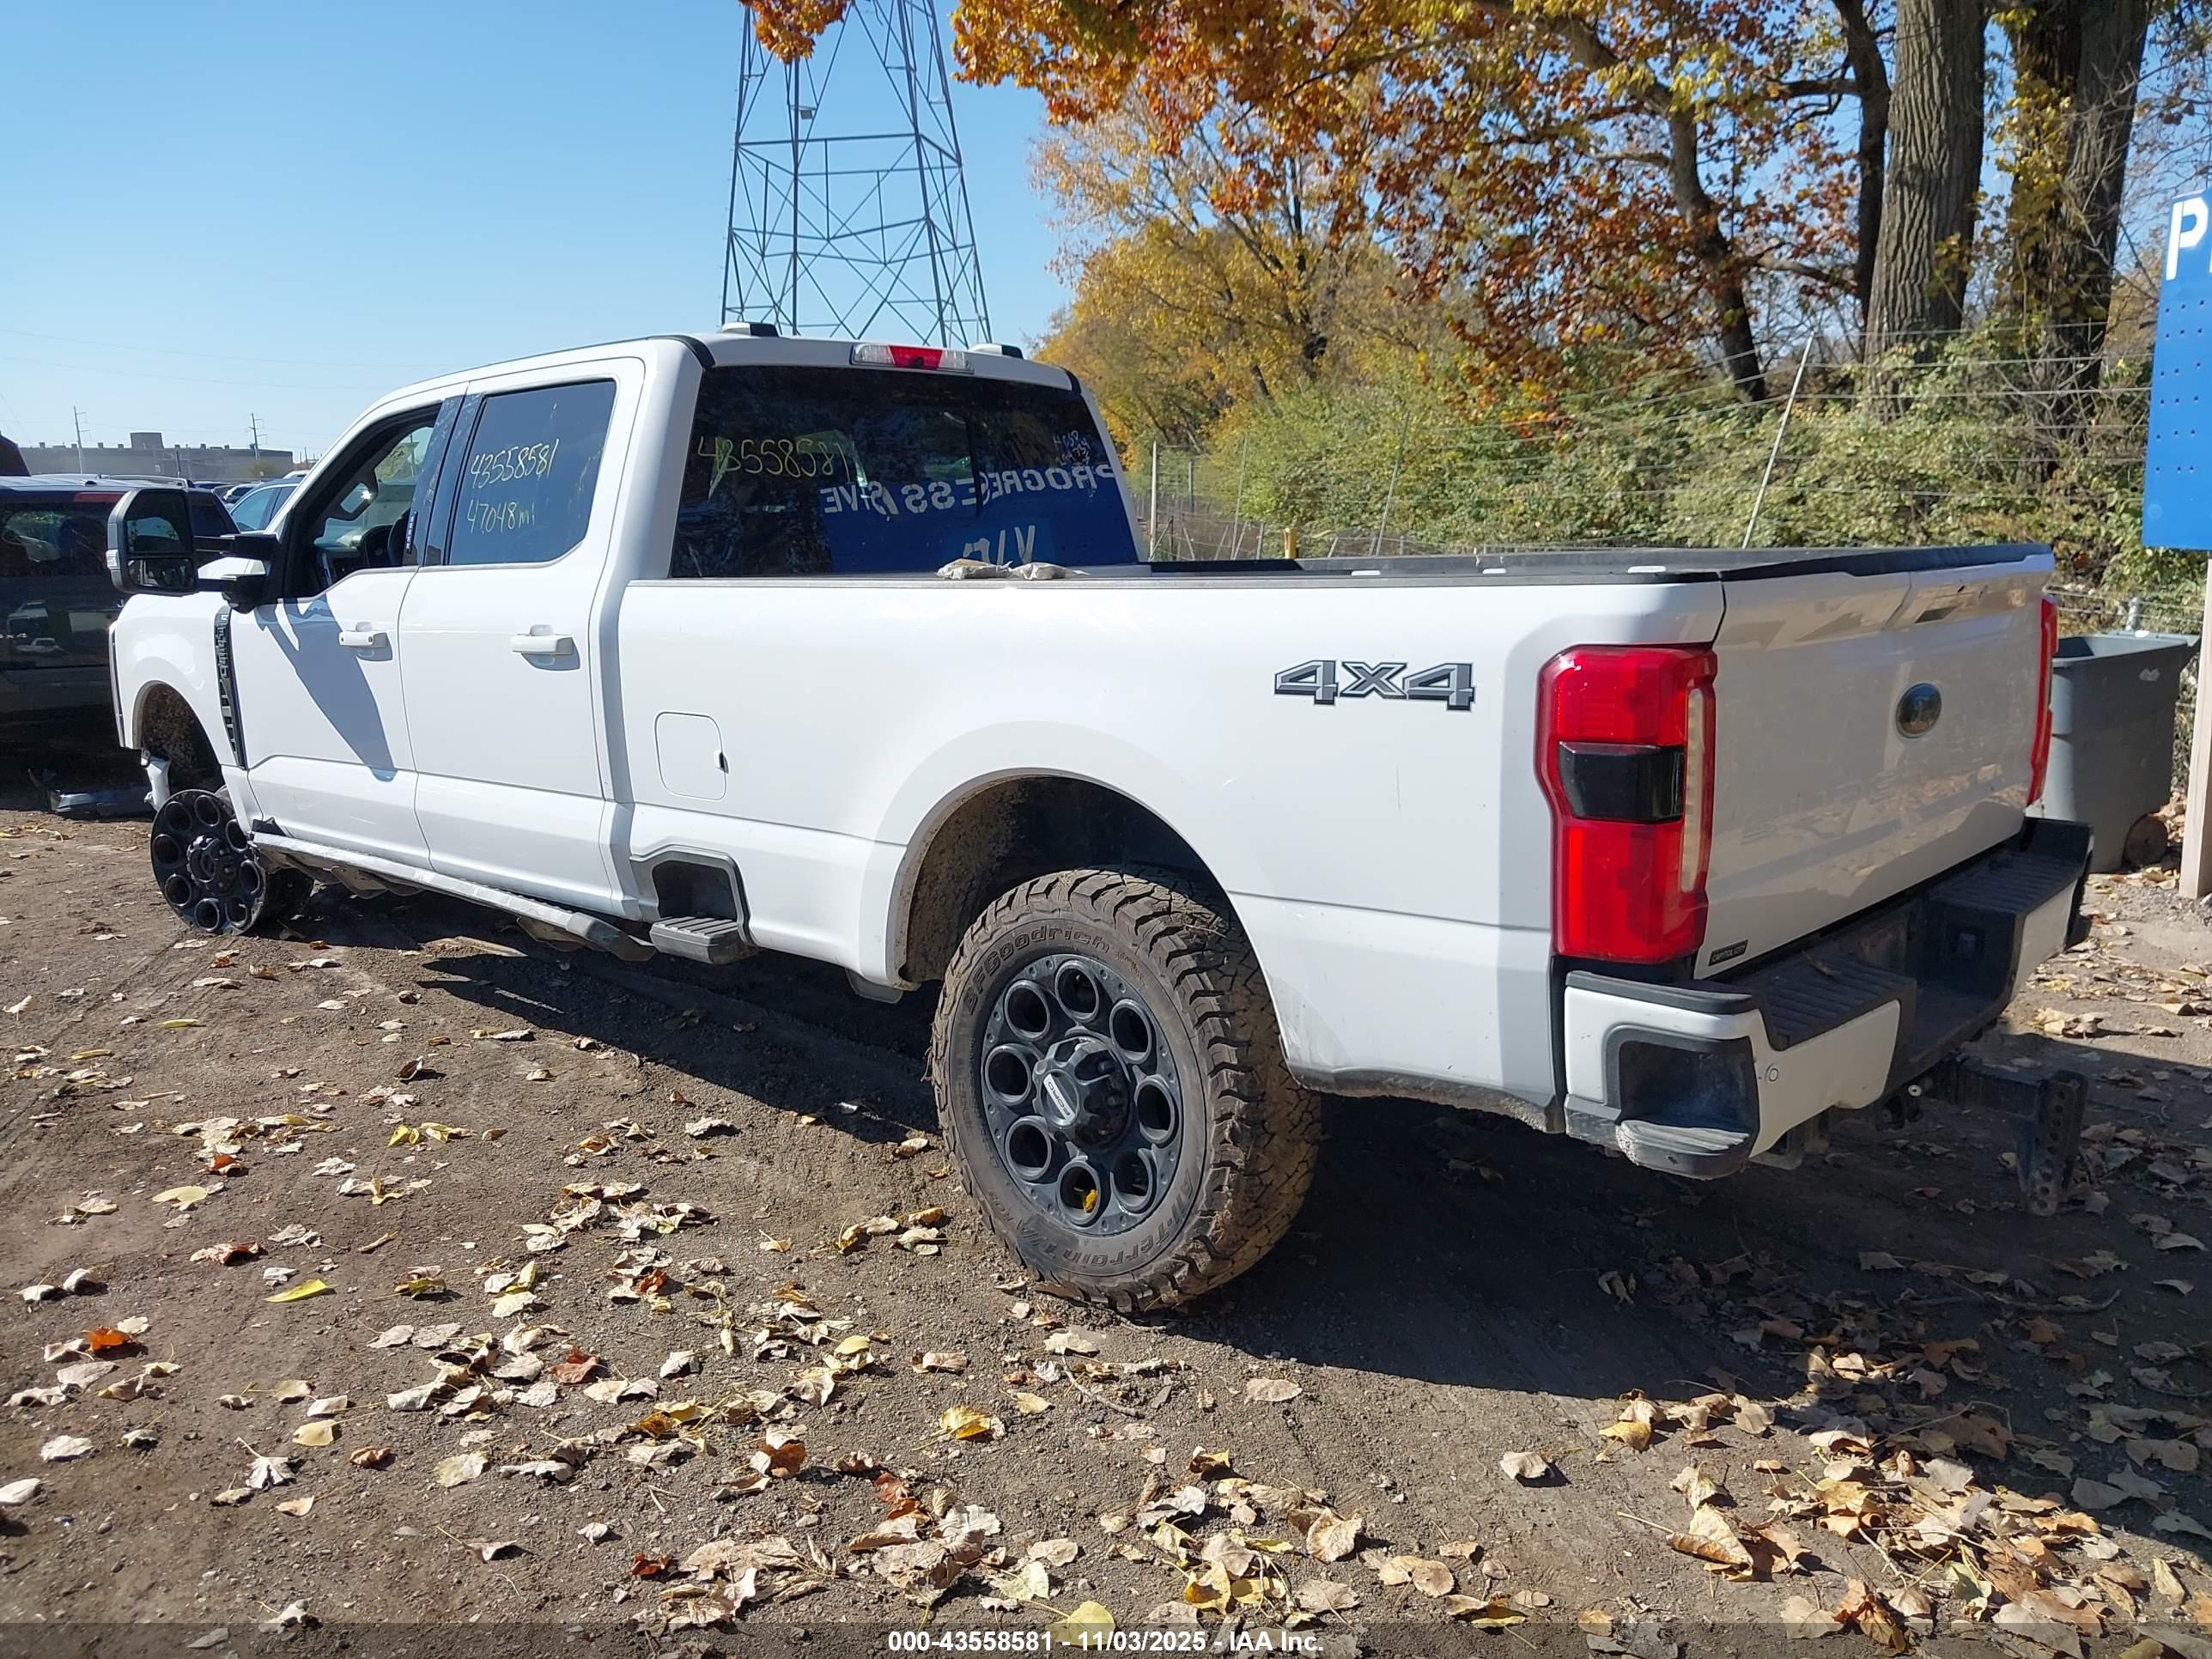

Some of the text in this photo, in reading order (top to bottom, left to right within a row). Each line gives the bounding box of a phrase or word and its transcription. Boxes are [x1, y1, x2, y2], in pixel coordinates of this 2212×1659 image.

[471, 438, 559, 489] 43558581
[697, 435, 849, 484] 43558581
[963, 924, 1110, 1016] BFGoodrich
[1048, 1082, 1071, 1116] FORD
